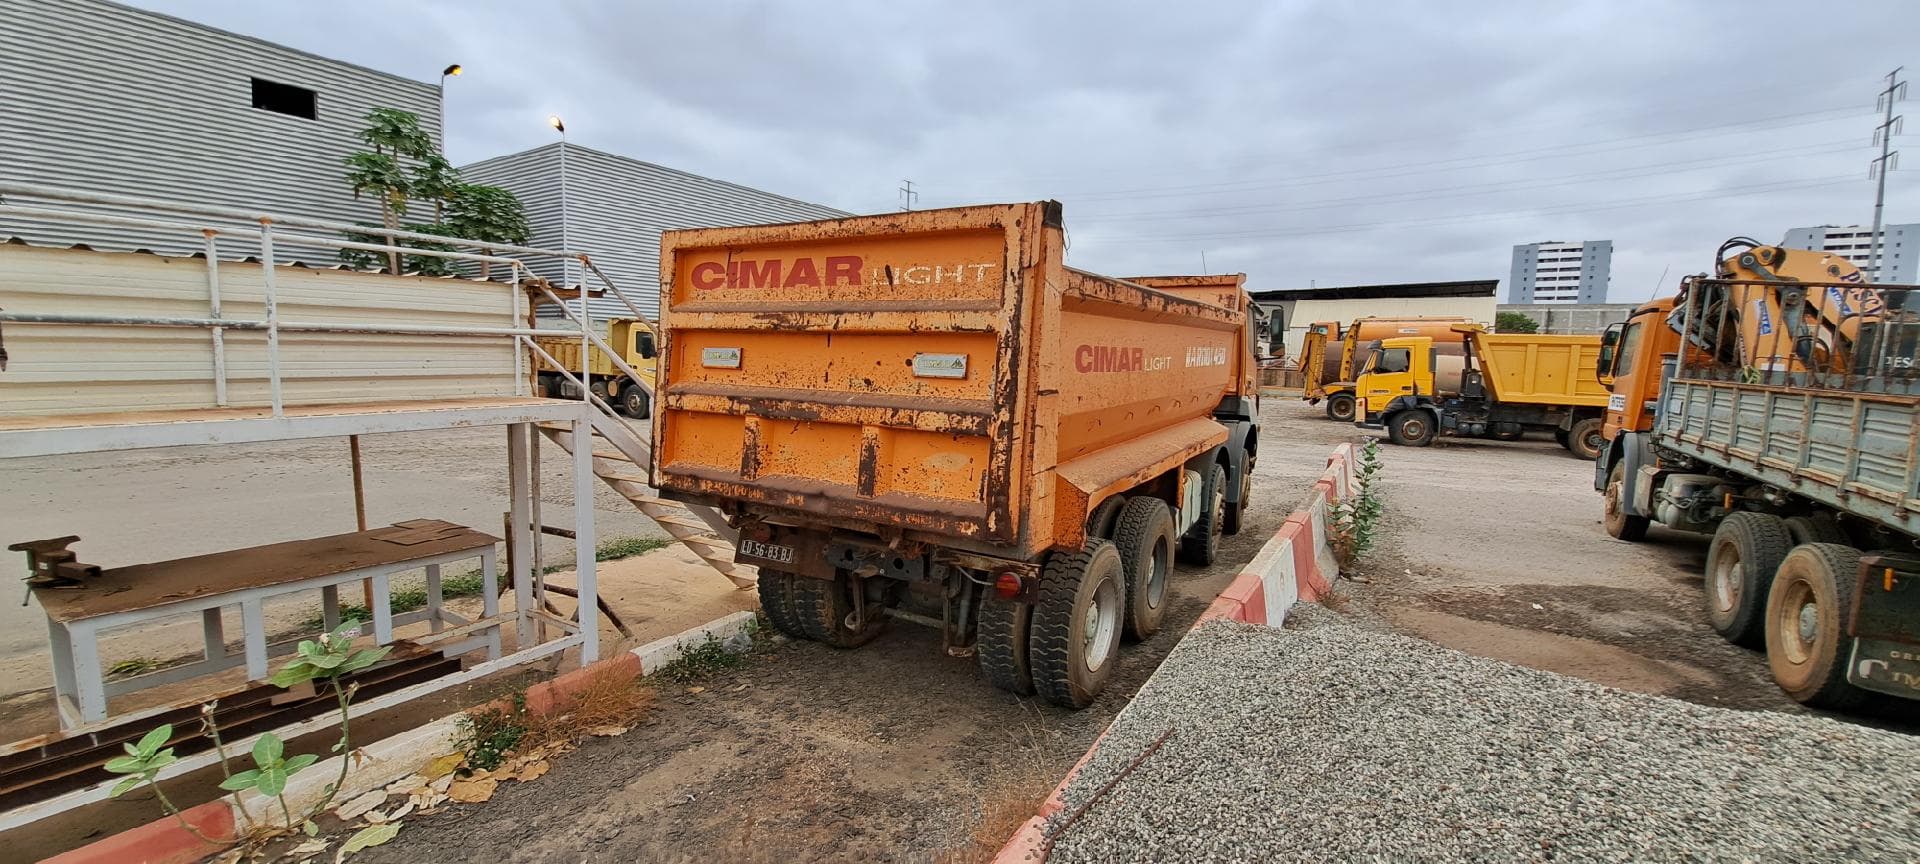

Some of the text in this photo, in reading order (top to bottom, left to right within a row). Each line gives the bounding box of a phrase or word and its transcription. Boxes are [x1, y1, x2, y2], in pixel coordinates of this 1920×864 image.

[691, 255, 996, 291] CIMAR LIGHT
[1074, 344, 1172, 374] CIMAR LIGHT
